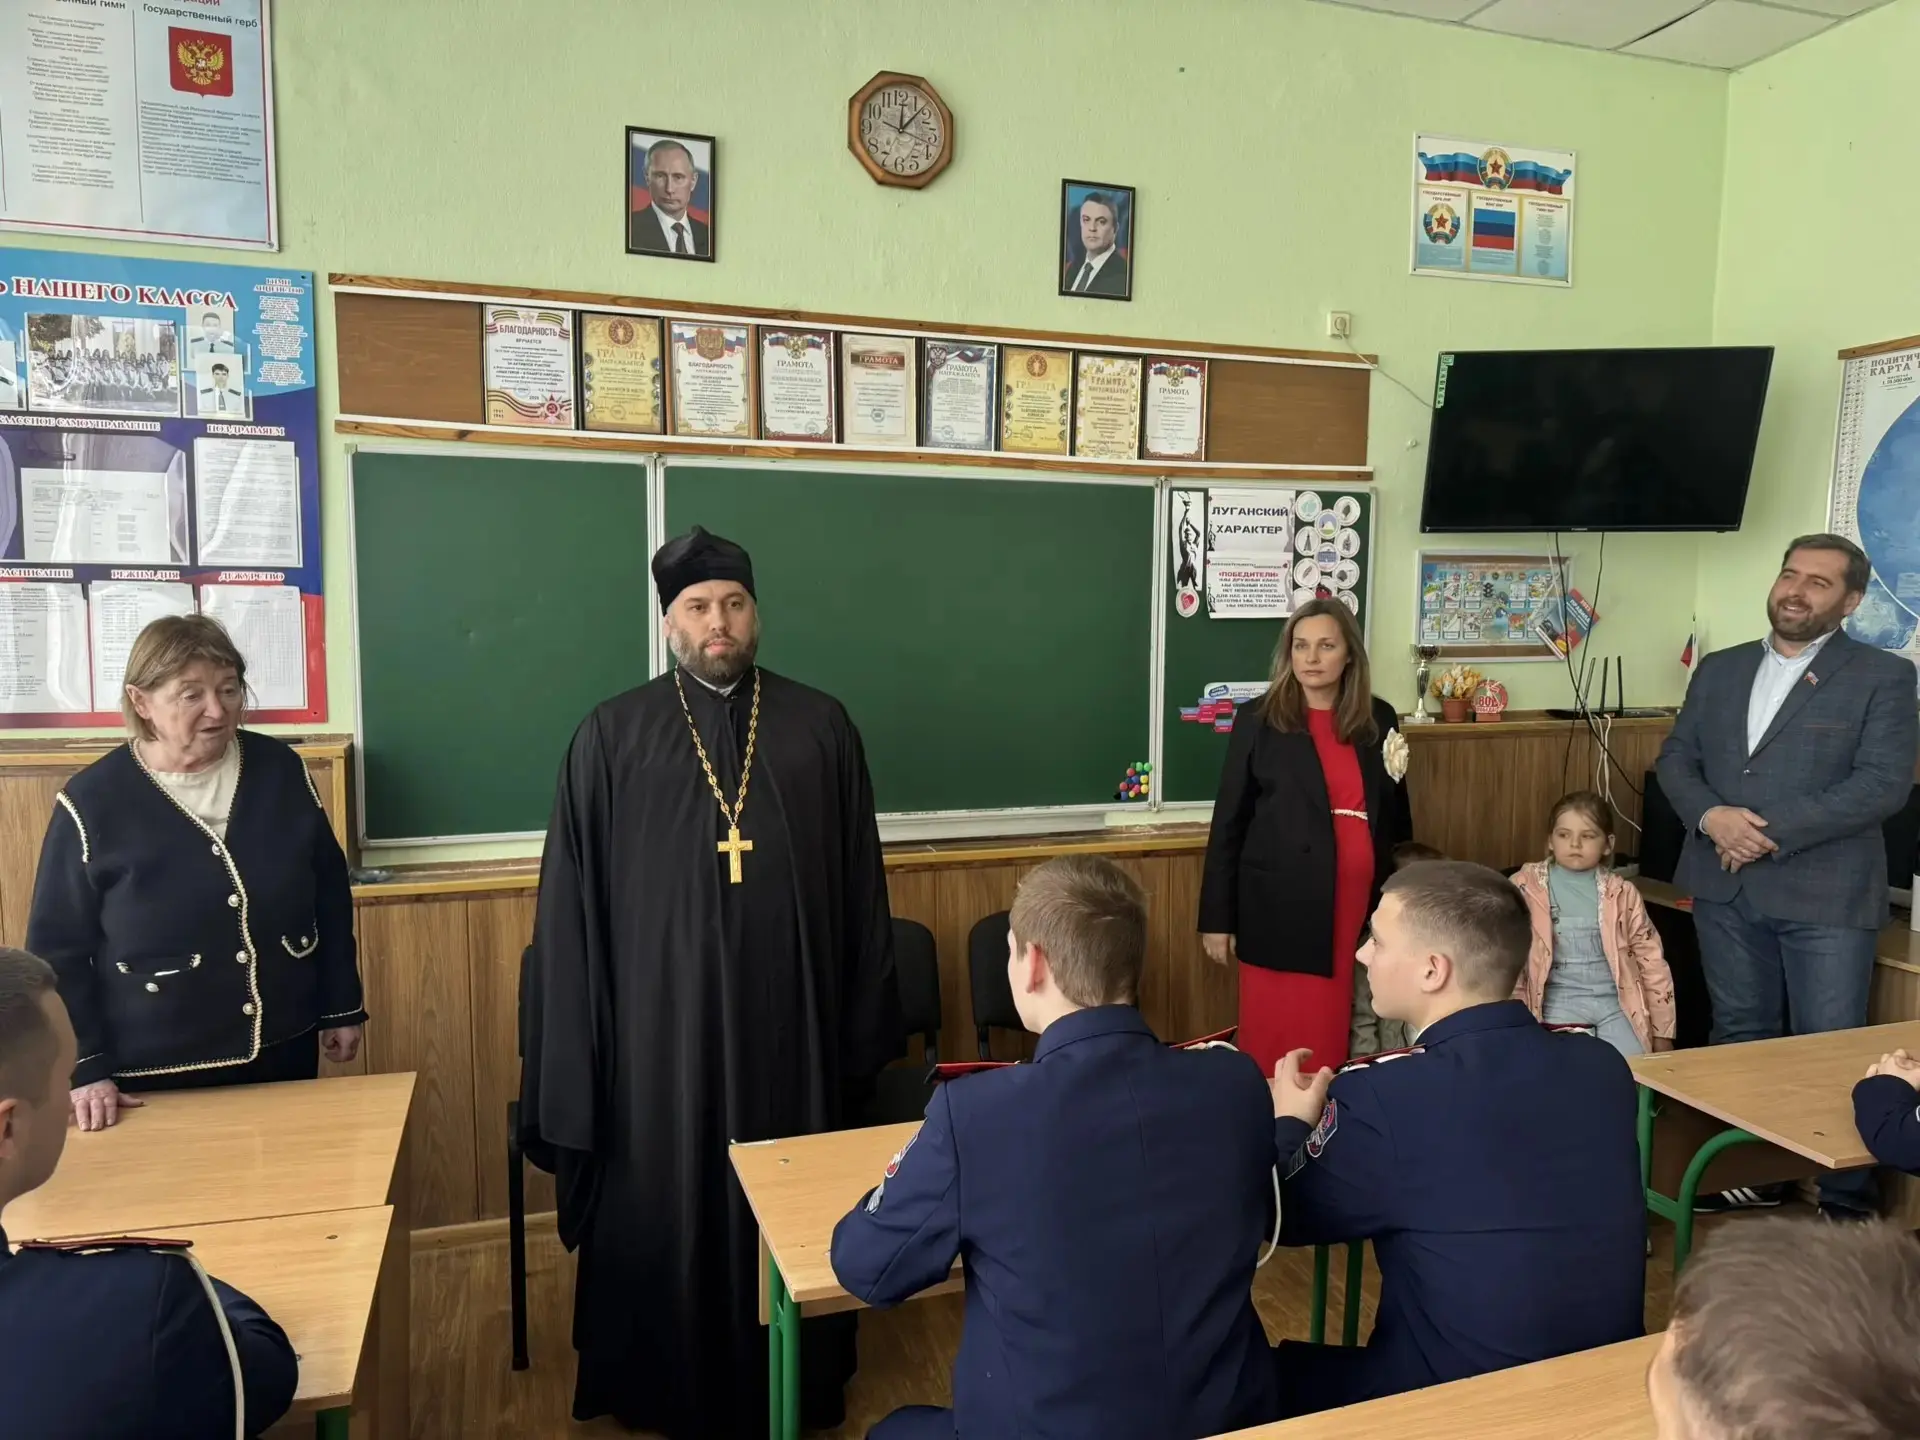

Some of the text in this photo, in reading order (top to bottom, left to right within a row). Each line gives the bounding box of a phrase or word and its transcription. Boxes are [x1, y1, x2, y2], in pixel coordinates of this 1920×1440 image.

[143, 3, 258, 28] Государственный герб
[882, 92, 891, 108] 11
[894, 90, 908, 106] 12
[868, 103, 882, 120] 10
[921, 108, 931, 125] 2
[861, 119, 872, 135] 9
[928, 127, 937, 144] 3
[867, 137, 879, 154] 8
[880, 151, 890, 167] 7
[894, 156, 905, 173] 6
[909, 155, 919, 170] 5
[13, 278, 131, 302] НАШЕГО
[137, 286, 238, 310] КЛАССА
[499, 324, 558, 337] БЛАГОДАРНОСТЬ
[688, 361, 734, 370] БЛАГОДАРНОСТЬ
[777, 359, 814, 368] ГРАМОТА
[860, 356, 899, 365] ГРАМОТА
[946, 363, 978, 373] ГРАМОТА
[1870, 362, 1911, 377] КАРТА
[1159, 387, 1190, 396] ГРАМОТА
[206, 423, 286, 437] ПОЗДРАВЛЯЕМ
[1211, 506, 1289, 517] ЛУГАНСКИЙ
[1216, 524, 1283, 534] ХАРАКТЕР
[219, 571, 286, 583] ДЕЖУРСТВО
